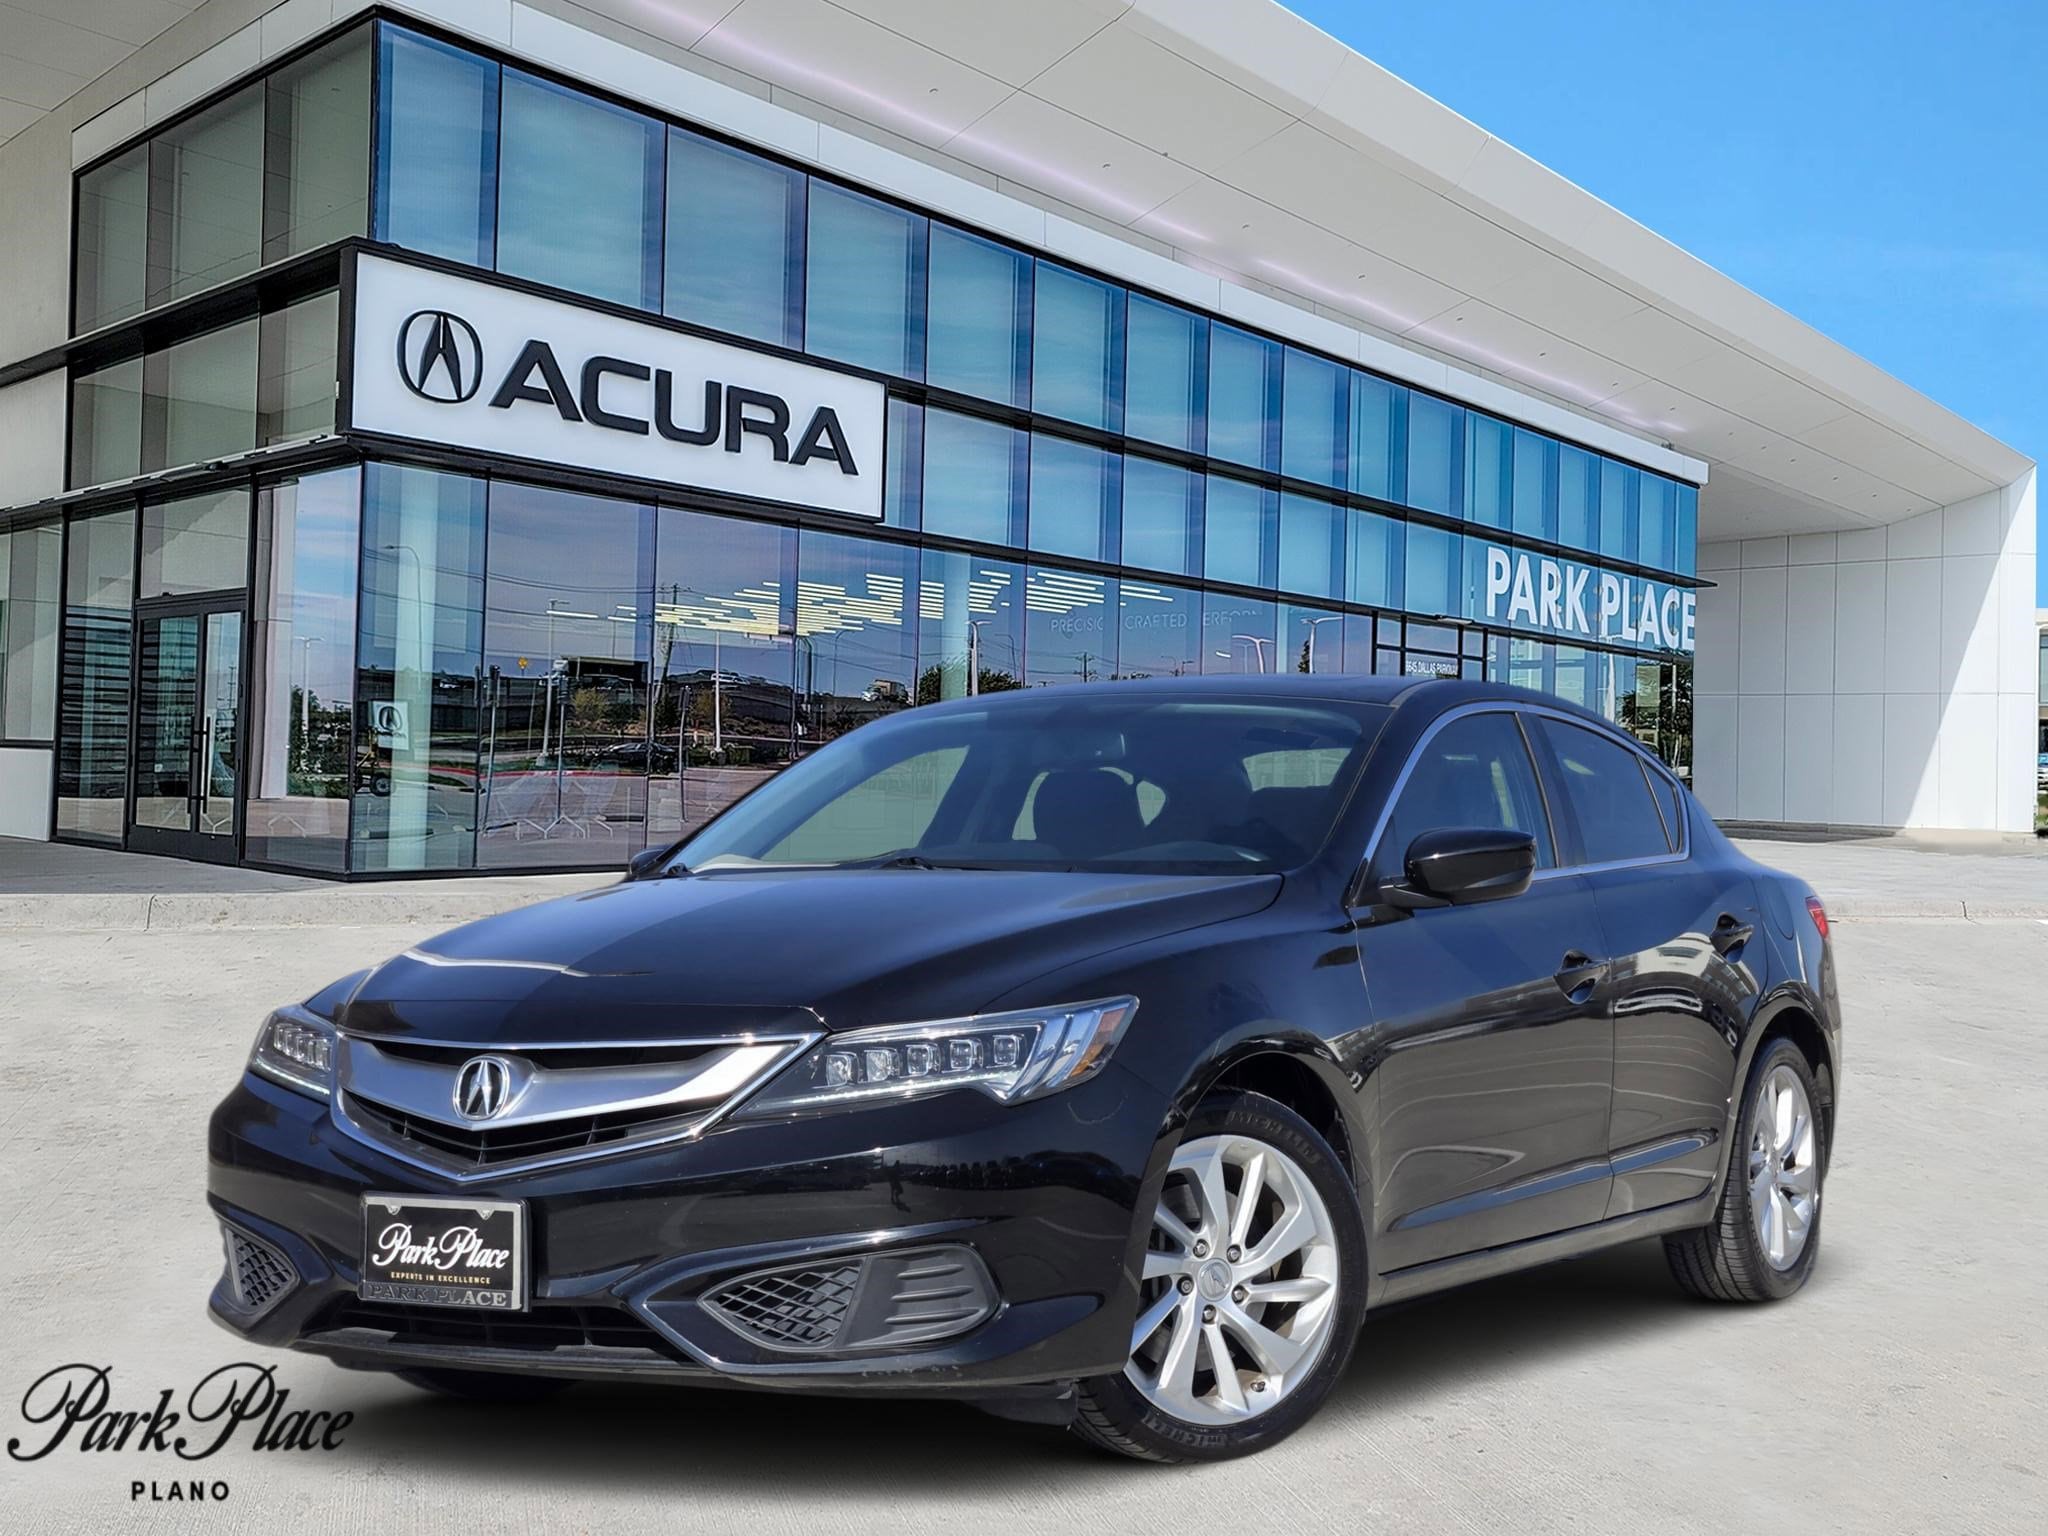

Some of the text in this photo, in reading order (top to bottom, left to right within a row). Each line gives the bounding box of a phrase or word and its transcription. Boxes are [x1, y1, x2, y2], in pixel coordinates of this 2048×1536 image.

[488, 339, 859, 476] ACURA
[1487, 546, 1696, 651] PARK PLACE
[372, 1223, 510, 1270] Park Place
[368, 1284, 507, 1306] PARK PLACE
[391, 1271, 423, 1281] EXPERTS
[438, 1275, 491, 1285] EXCELLENCE
